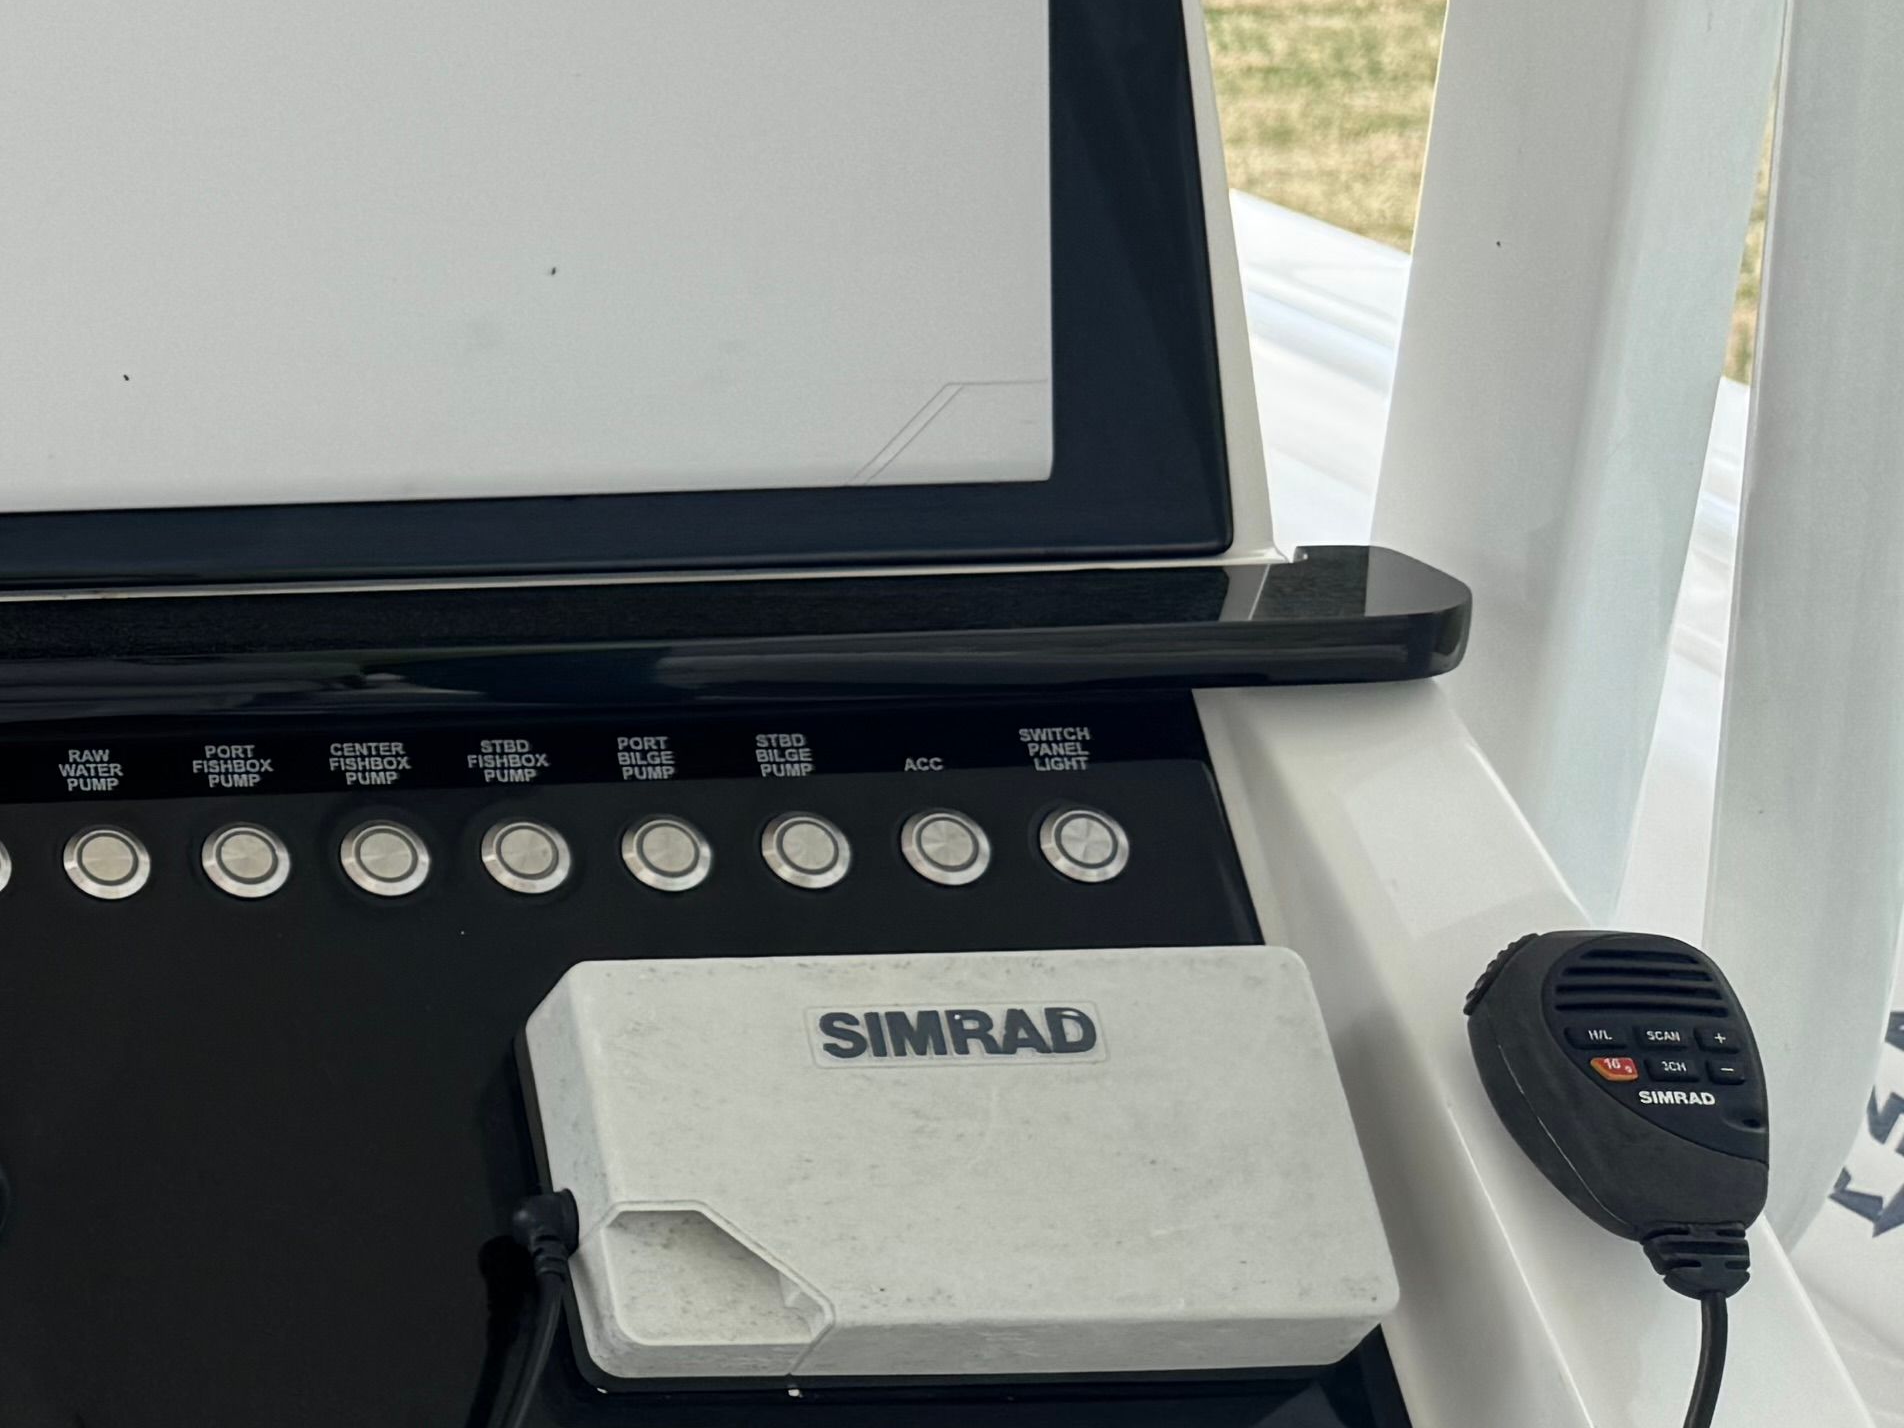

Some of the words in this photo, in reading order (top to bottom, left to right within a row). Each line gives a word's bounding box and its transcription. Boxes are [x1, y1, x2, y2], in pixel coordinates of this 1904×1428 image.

[756, 733, 806, 748] STBD
[1019, 727, 1090, 743] SWITCH
[330, 742, 405, 757] CENTER
[480, 740, 530, 754] STBD
[617, 736, 669, 751] PORT
[1028, 742, 1090, 757] PANEL
[68, 749, 111, 764] RAW
[204, 745, 255, 759] PORT
[618, 750, 675, 766] BILGE
[755, 747, 812, 763] BILGE
[193, 759, 273, 774] FISHBOX
[330, 756, 411, 772] FISHBOX
[468, 753, 548, 769] FISHBOX
[904, 758, 943, 772] ACC
[1033, 756, 1088, 771] LIGHT
[59, 763, 122, 778] WATER
[485, 768, 537, 783] PUMP
[622, 765, 675, 780] PUMP
[761, 762, 813, 777] PUMP
[67, 777, 119, 792] PUMP
[208, 773, 261, 788] PUMP
[346, 771, 398, 786] PUMP
[819, 1007, 1097, 1058] SIMRAD
[1588, 1030, 1613, 1041] H/L
[1646, 1030, 1681, 1042] SCAN
[1638, 1090, 1716, 1105] SIMRAD
